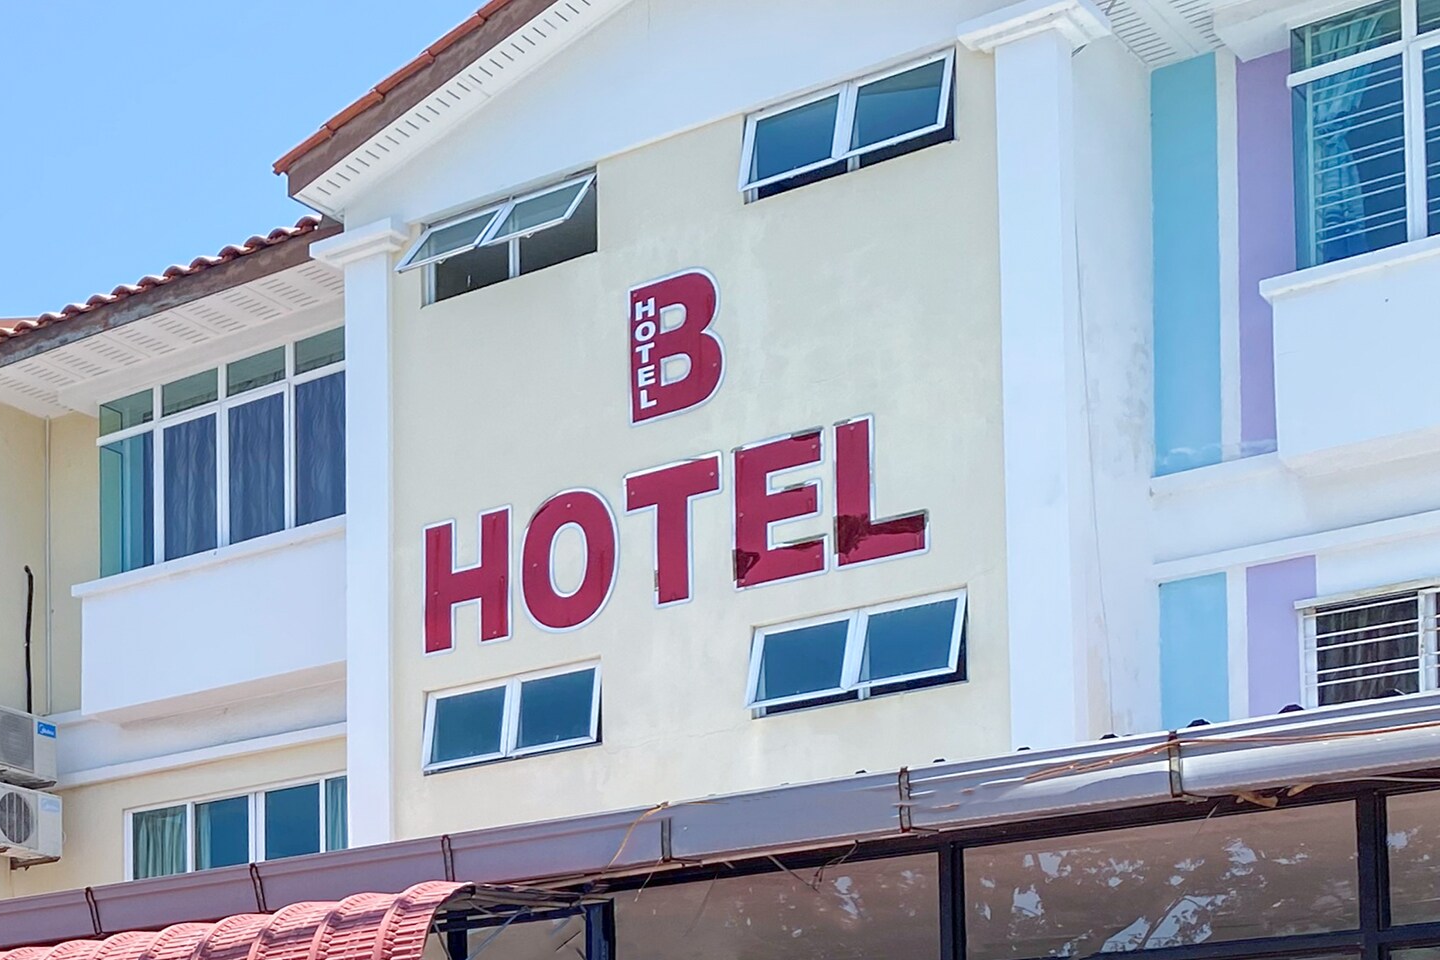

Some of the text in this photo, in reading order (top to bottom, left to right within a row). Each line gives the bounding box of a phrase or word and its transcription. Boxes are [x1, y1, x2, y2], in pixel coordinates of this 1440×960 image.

[629, 267, 725, 425] B
[633, 297, 658, 411] HOTEL
[422, 413, 931, 657] HOTEL
